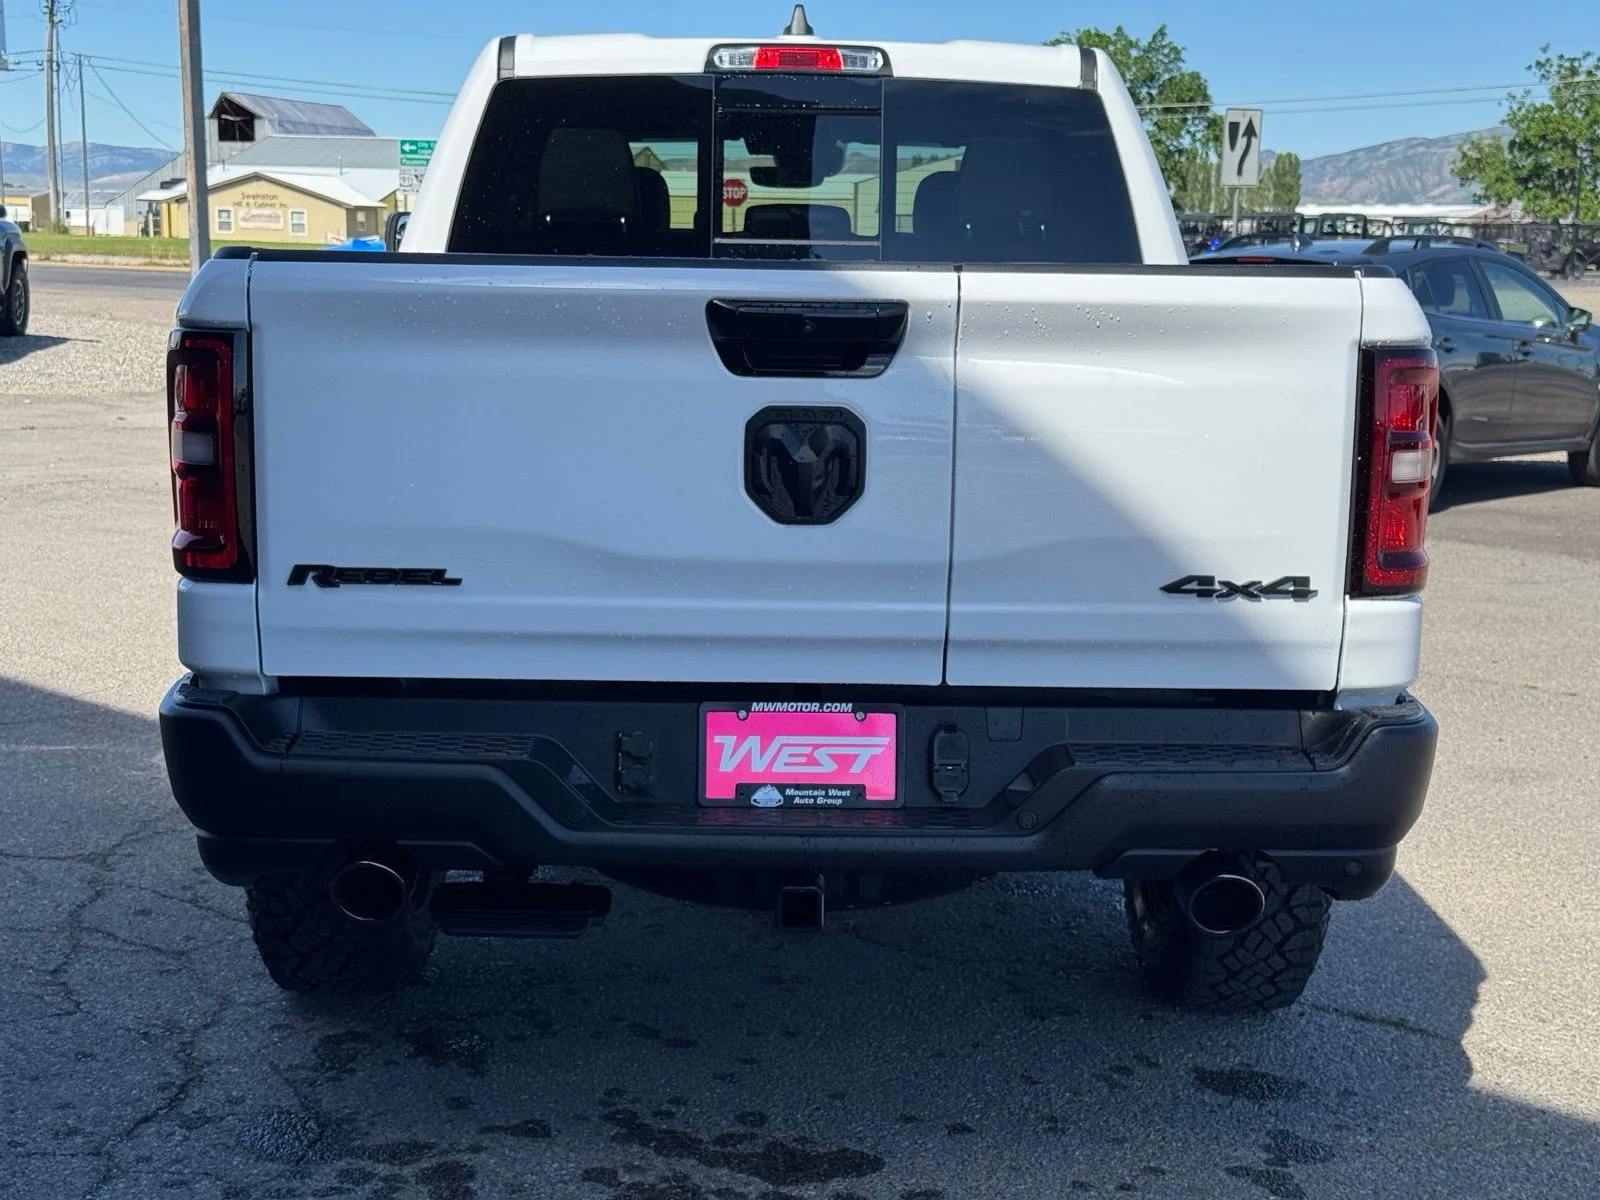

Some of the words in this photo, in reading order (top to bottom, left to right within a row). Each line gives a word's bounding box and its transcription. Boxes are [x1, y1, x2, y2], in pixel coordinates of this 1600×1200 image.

[723, 187, 746, 199] STOP
[287, 564, 463, 588] REBEL
[1159, 575, 1319, 602] 4x4
[751, 702, 853, 713] MWMOTOR.COM
[713, 735, 891, 773] WEST
[785, 788, 826, 796] Mountain
[828, 789, 851, 797] West
[816, 797, 842, 805] Group
